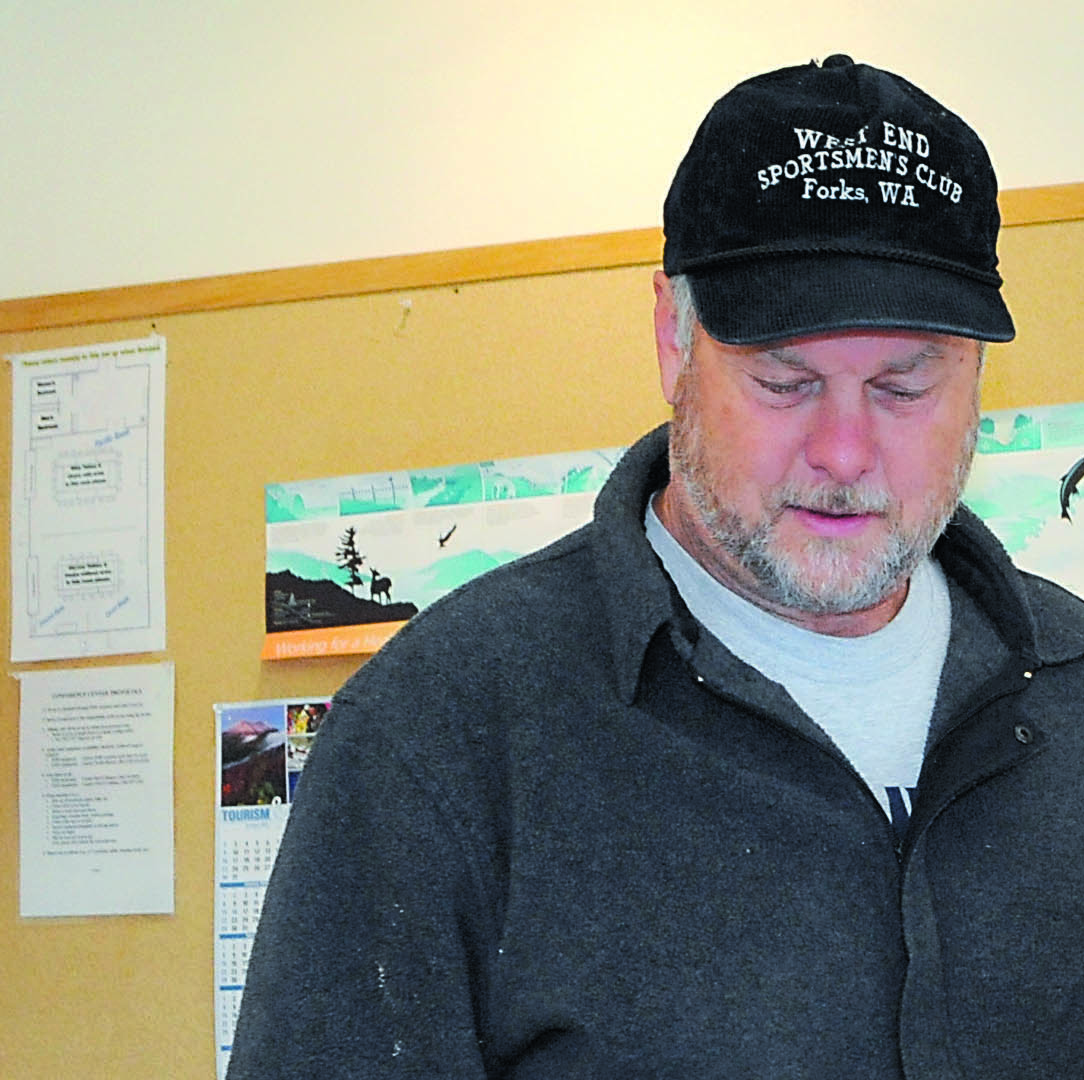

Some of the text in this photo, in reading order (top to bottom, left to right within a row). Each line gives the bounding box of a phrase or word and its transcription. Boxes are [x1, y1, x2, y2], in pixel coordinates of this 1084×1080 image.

[883, 121, 930, 158] END
[757, 147, 963, 204] SPORTSMEN'S CLUB
[802, 178, 919, 207] Forks, WA
[223, 808, 270, 822] TOURISM
